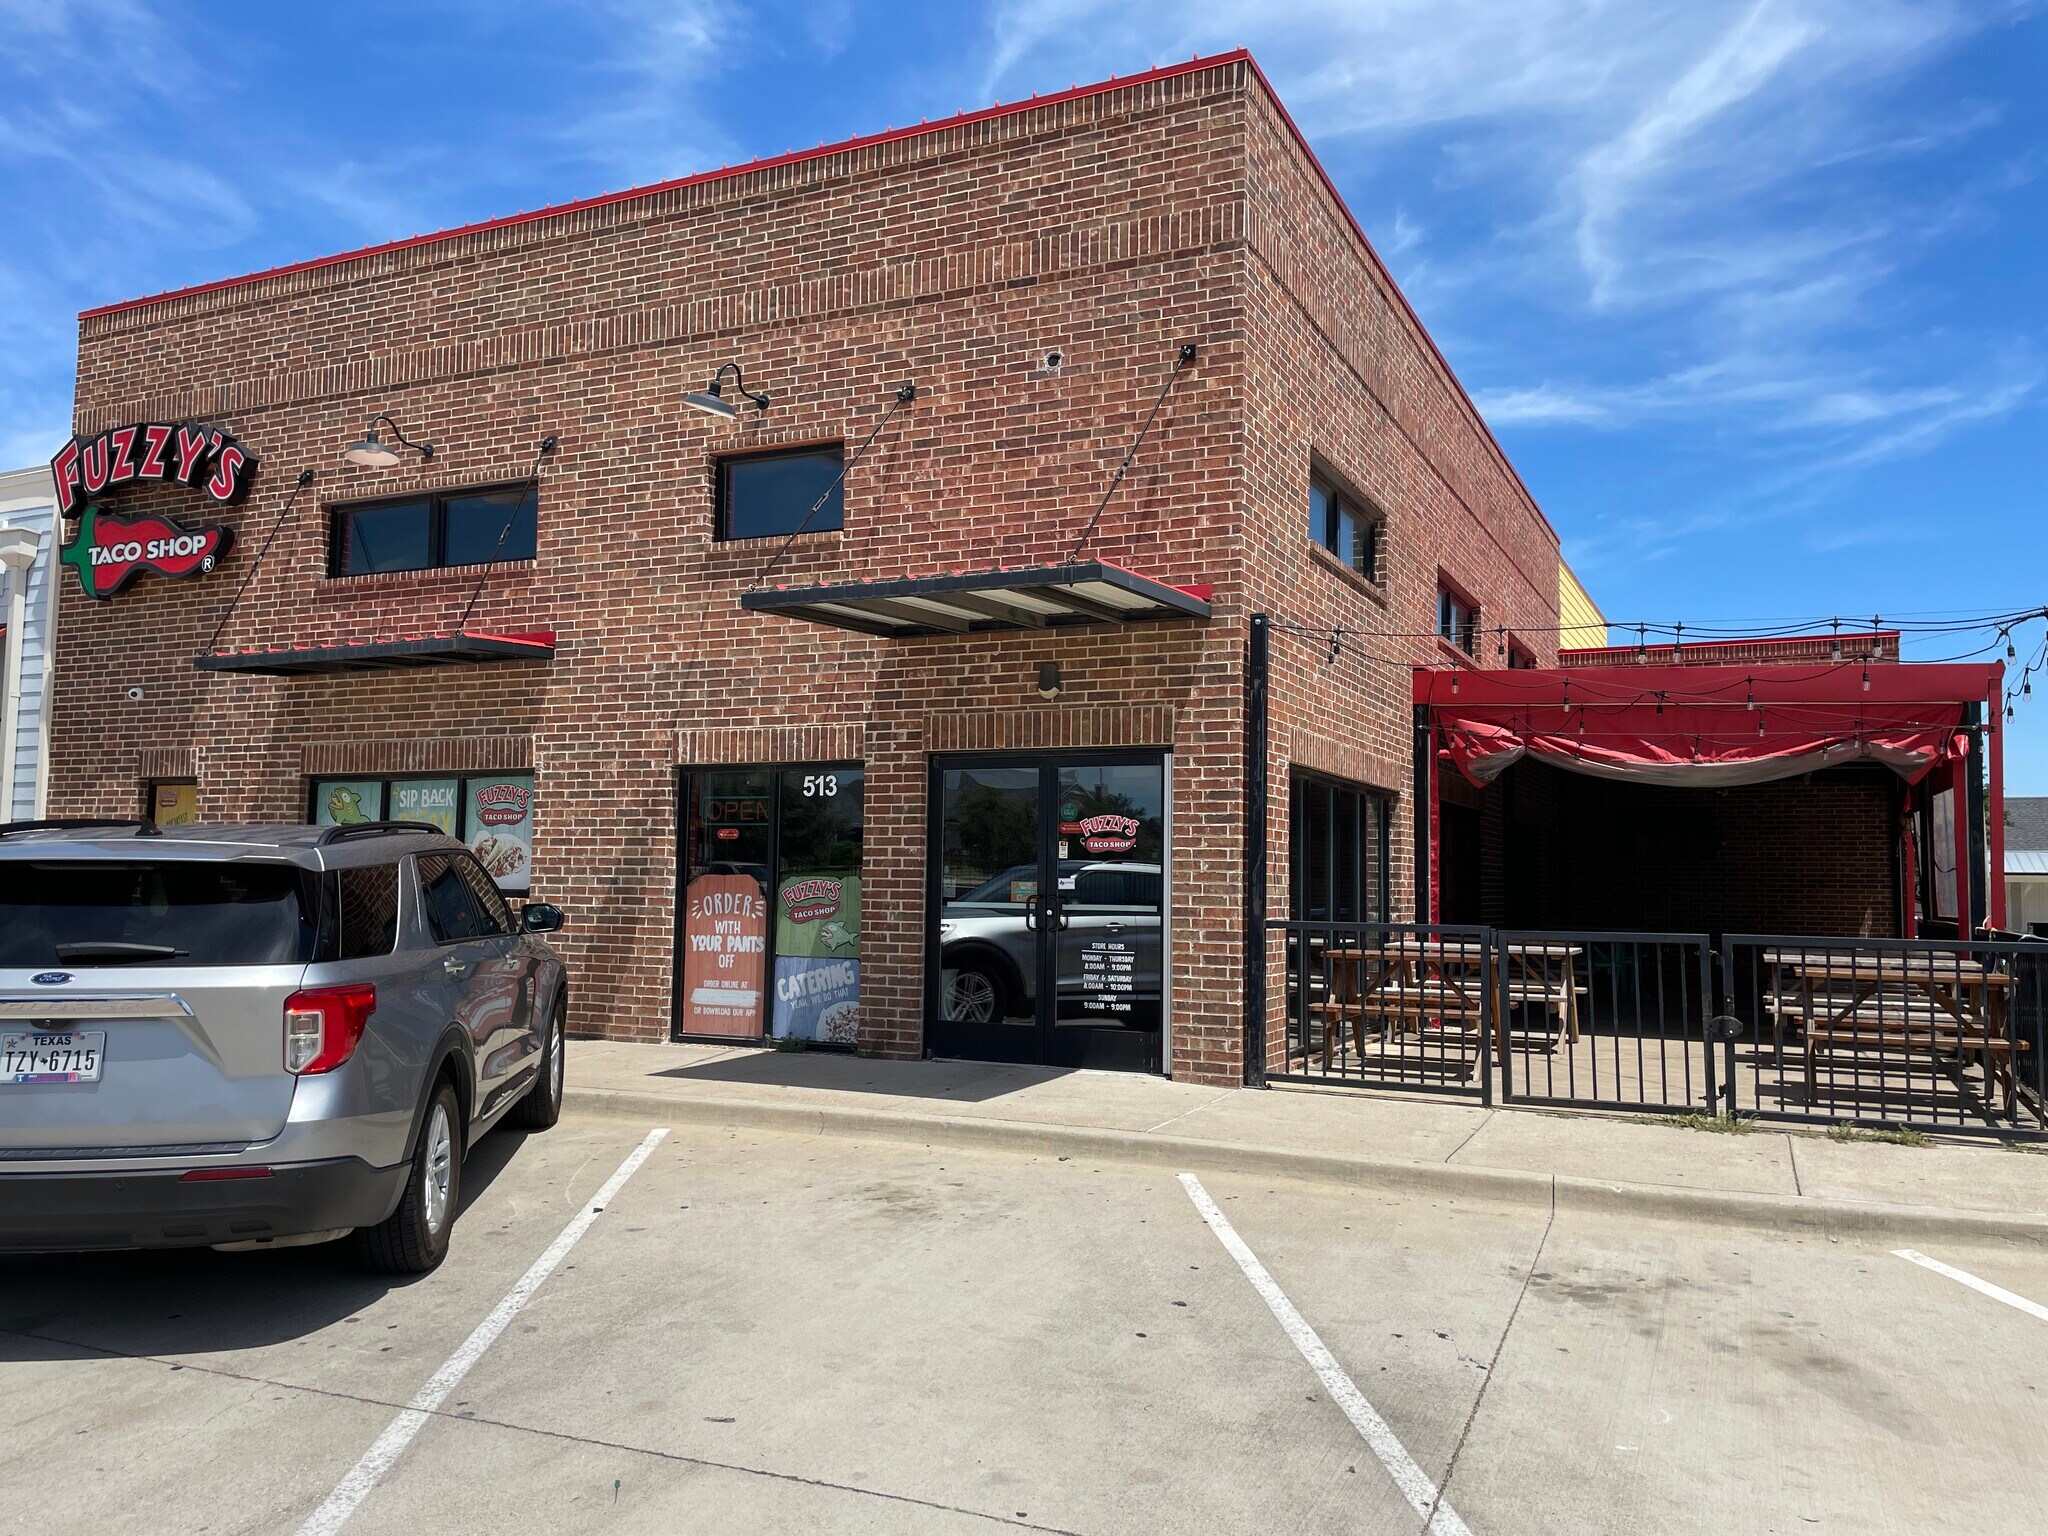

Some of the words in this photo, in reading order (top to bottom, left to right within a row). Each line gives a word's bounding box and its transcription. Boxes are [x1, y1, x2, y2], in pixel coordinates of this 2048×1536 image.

[52, 423, 247, 517] FUZZY'S
[88, 541, 142, 566] TACO
[146, 534, 207, 560] SHOP
[802, 775, 838, 797] 513
[399, 789, 418, 808] SIP
[421, 787, 454, 807] BACK
[476, 784, 531, 809] FUZZY'S
[503, 813, 523, 821] SHOP
[705, 801, 769, 820] OPEN
[1079, 815, 1140, 837] FUZZY'S
[781, 880, 842, 908] FUZZY'S
[703, 892, 753, 917] ORDER
[794, 910, 814, 919] TACO
[814, 906, 836, 917] SHOP
[714, 920, 741, 934] WITH
[690, 934, 723, 952] YOUR
[727, 935, 765, 953] PANTS
[1091, 942, 1107, 950] STORE
[1108, 943, 1125, 951] HOURS
[718, 954, 735, 968] OFF
[1081, 954, 1103, 962] MONDAY
[1109, 955, 1134, 963] THURSDAY
[39, 973, 65, 982] Ford
[703, 980, 720, 988] ORDER
[721, 980, 739, 989] ONLINE
[741, 981, 748, 989] AT
[777, 961, 855, 1002] CATERING
[1083, 973, 1100, 981] FRIDAY
[1107, 974, 1132, 983] SATURDAY
[811, 995, 822, 1005] WE
[823, 992, 832, 1001] DO
[834, 987, 849, 999] THAT
[1097, 994, 1117, 1002] SUNDAY
[693, 1006, 702, 1015] OR
[703, 1007, 731, 1016] DOWNLOAD
[732, 1008, 744, 1017] OUR
[745, 1008, 757, 1017] APP
[33, 1036, 72, 1046] TEXAS
